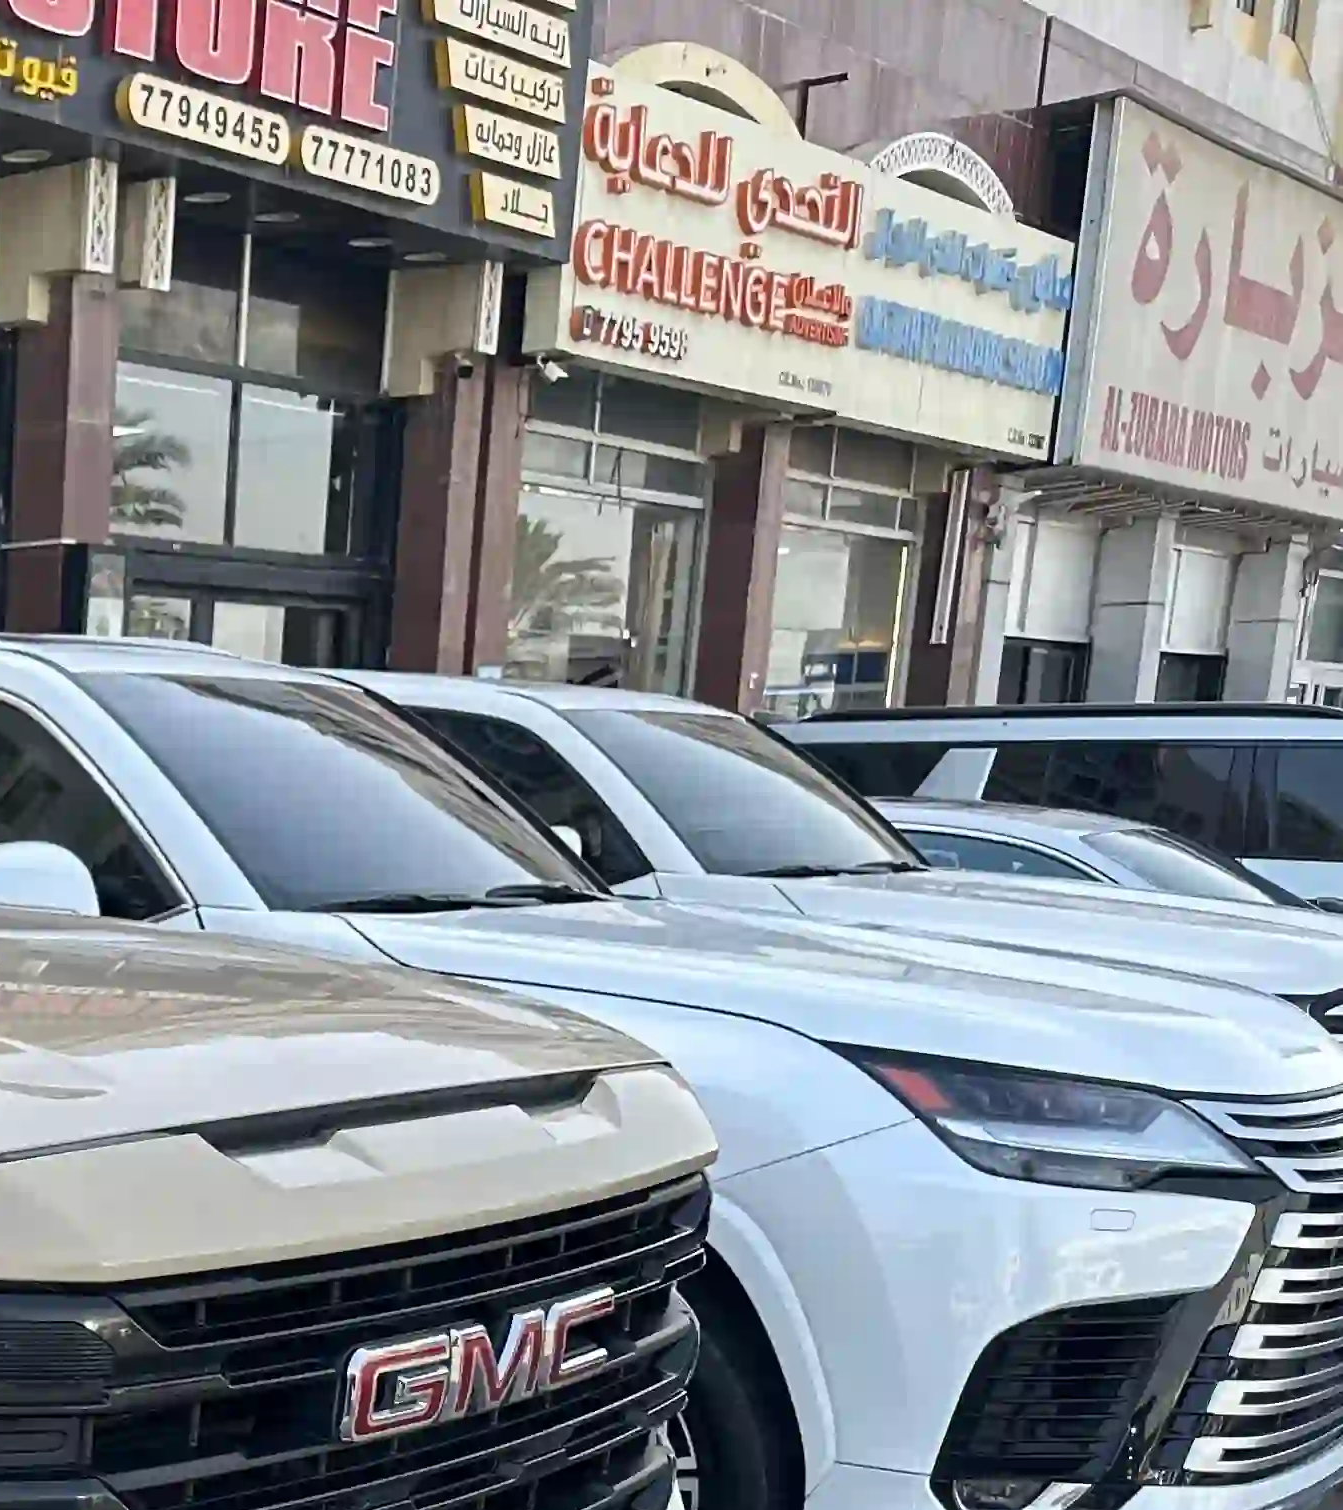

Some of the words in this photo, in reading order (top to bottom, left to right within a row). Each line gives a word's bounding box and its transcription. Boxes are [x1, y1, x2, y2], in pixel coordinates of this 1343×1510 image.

[140, 83, 282, 154] 77949455
[309, 134, 433, 198] 77771083
[583, 76, 733, 205] للدعاية
[574, 219, 790, 331] CHALLENGE
[598, 310, 645, 349] 7795
[1100, 385, 1189, 468] AL-ZUBARA
[1187, 408, 1251, 482] MOTORS
[339, 1286, 615, 1443] GMC
